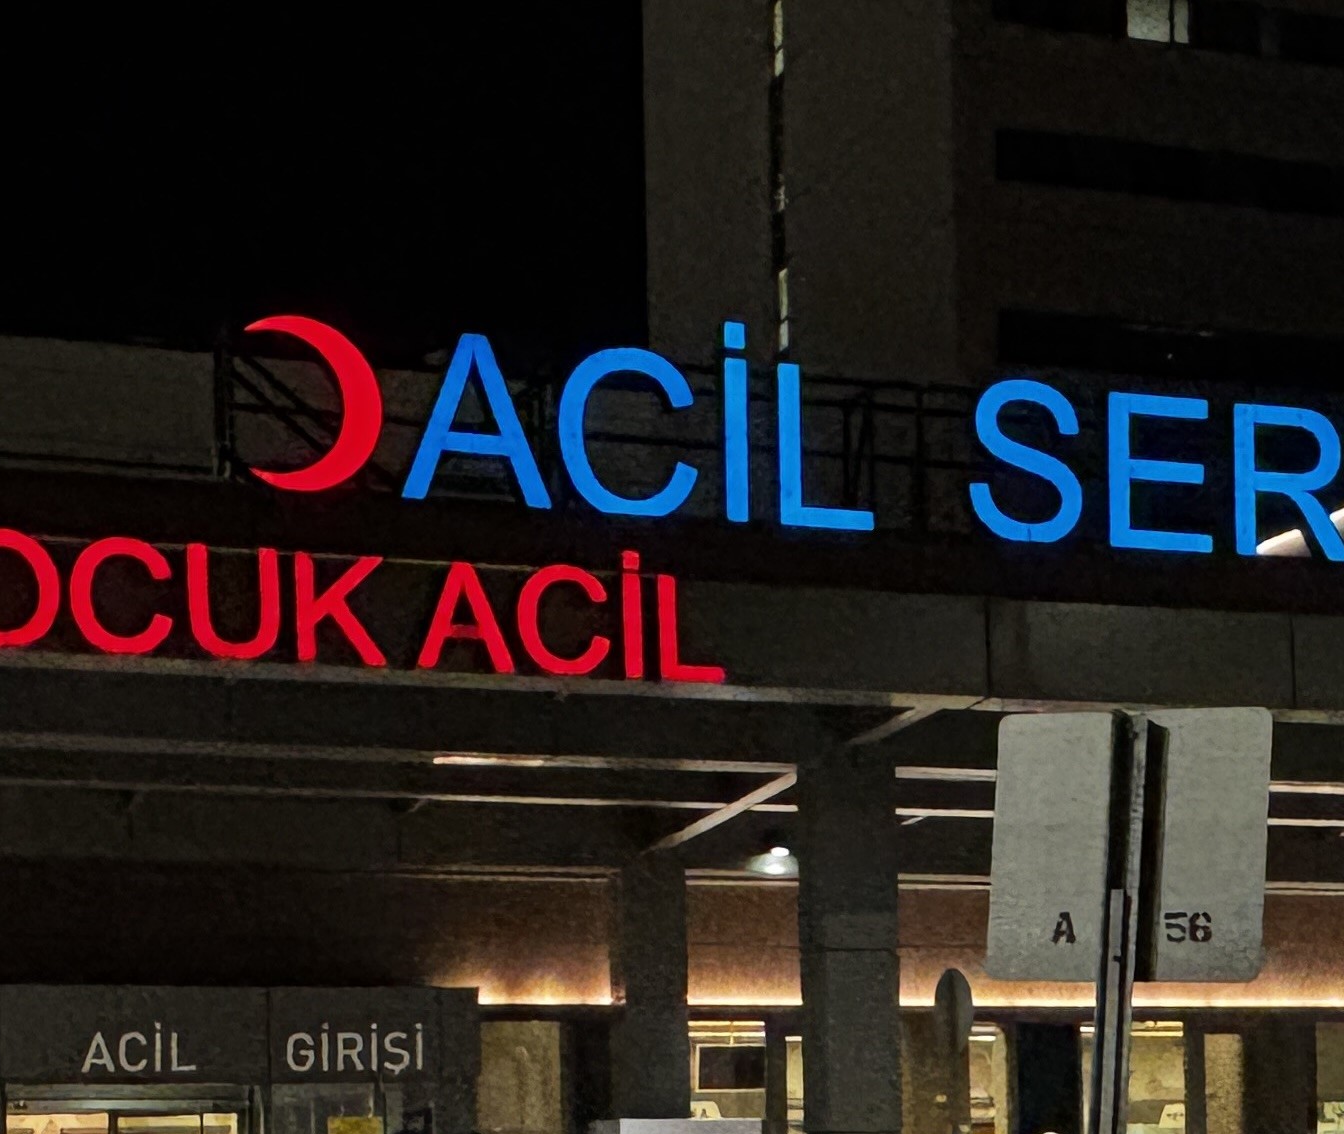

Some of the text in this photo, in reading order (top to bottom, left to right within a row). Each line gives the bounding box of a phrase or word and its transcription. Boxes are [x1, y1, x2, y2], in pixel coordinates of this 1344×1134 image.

[401, 320, 875, 531] ACİL
[417, 549, 726, 685] ACİL
[1050, 911, 1076, 944] A
[1164, 911, 1213, 943] 56
[80, 1021, 197, 1073] ACİL
[285, 1021, 424, 1075] GİRİŞİ
